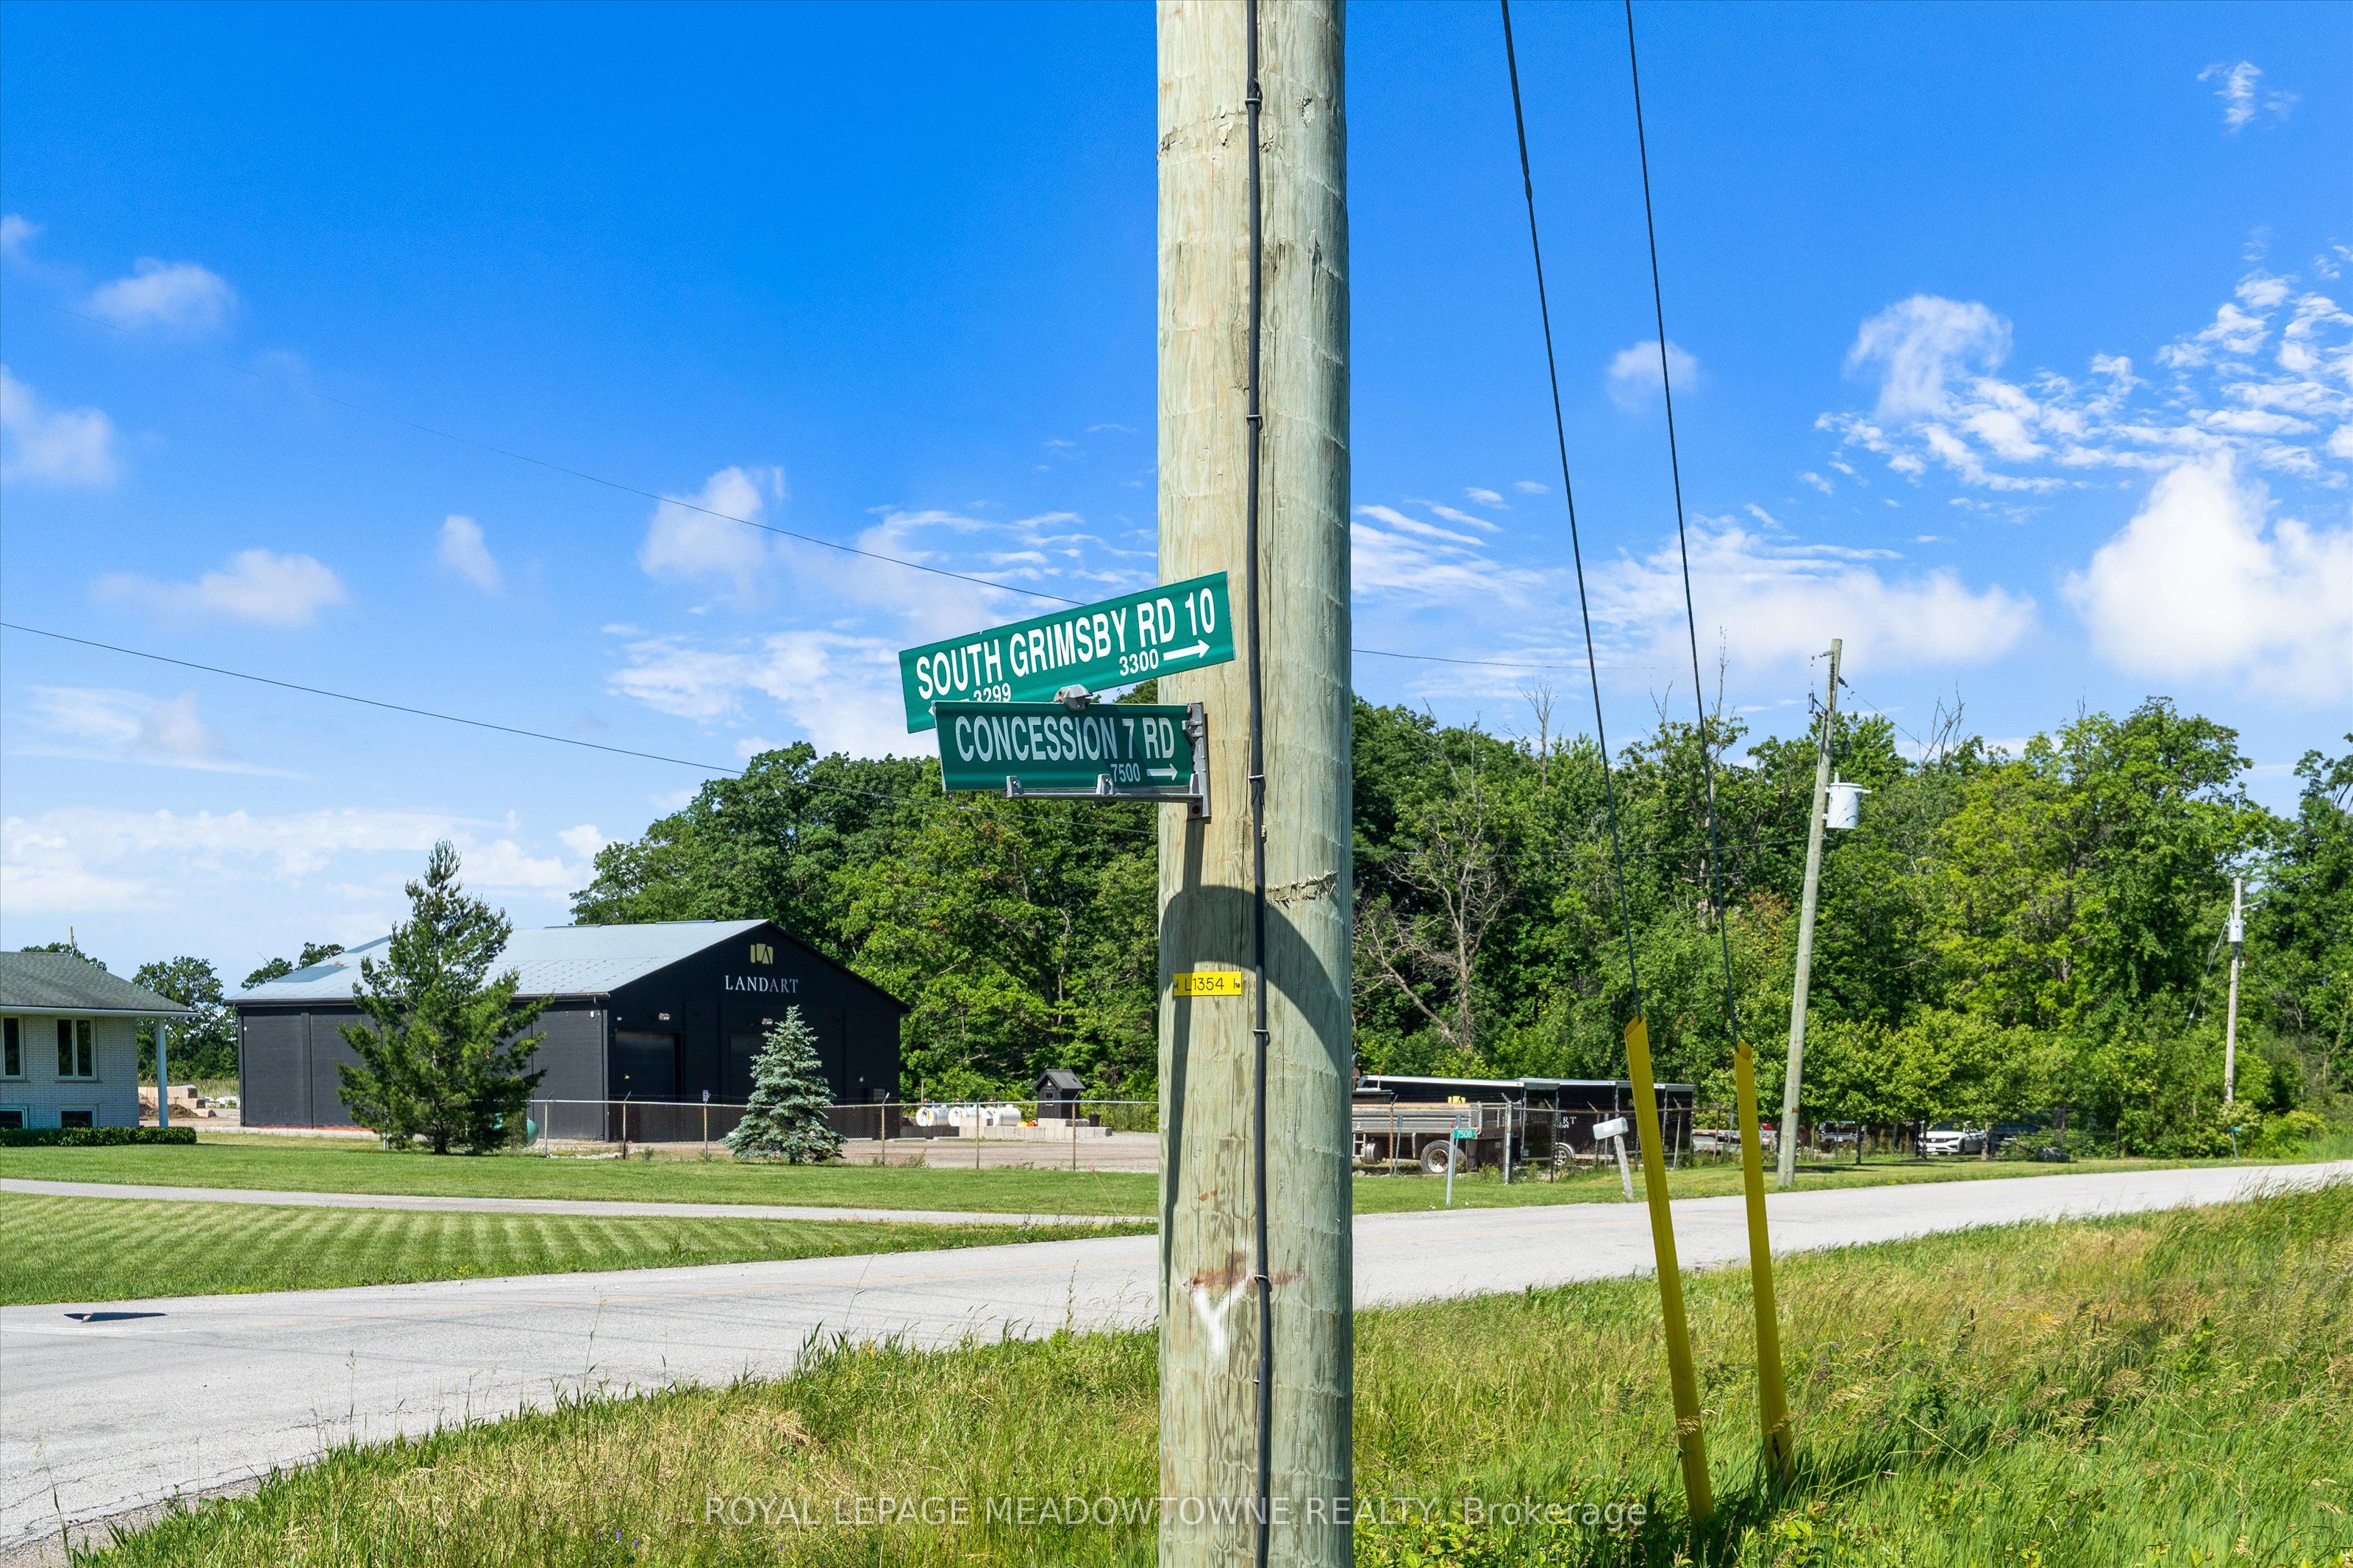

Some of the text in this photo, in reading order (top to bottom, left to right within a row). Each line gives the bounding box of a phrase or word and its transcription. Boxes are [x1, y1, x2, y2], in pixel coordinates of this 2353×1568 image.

[916, 588, 1215, 700] SOUTH GRIMSBY RD 10
[1119, 648, 1159, 676] 3300
[973, 682, 1012, 702] 3299
[955, 715, 1175, 762] CONCESSION 7 RD
[1110, 763, 1141, 782] 7500
[724, 975, 799, 993] LANDART
[1185, 977, 1224, 991] L1354
[1457, 1130, 1473, 1139] 7508
